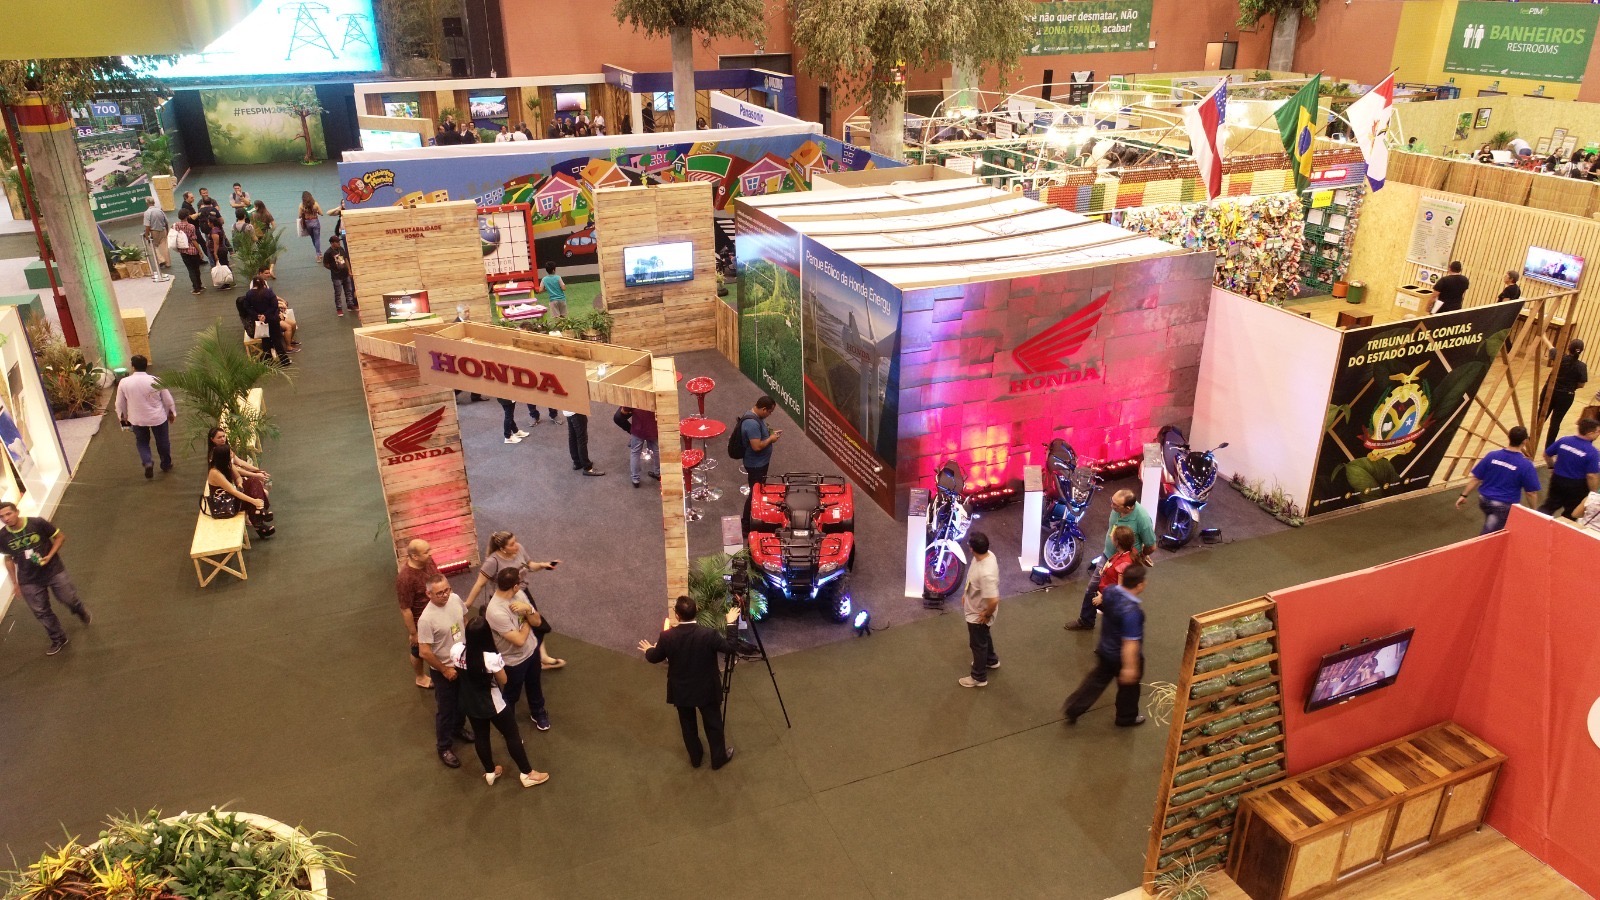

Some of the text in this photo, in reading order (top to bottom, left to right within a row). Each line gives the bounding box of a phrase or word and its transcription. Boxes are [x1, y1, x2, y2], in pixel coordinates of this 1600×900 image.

[1040, 12, 1055, 22] não
[1057, 13, 1076, 23] quer
[1078, 11, 1118, 21] desmatar,
[1121, 9, 1138, 20] NÃO
[1043, 25, 1066, 35] ZONA
[1102, 23, 1132, 34] acabar!
[1489, 25, 1586, 44] BANHEIROS
[1507, 42, 1559, 54] RESTROOMS
[95, 105, 116, 114] 700
[740, 103, 764, 123] Panasonic
[385, 225, 442, 235] SUSTENTABILIDADE
[806, 250, 824, 270] Parque
[840, 271, 848, 286] da
[848, 276, 868, 298] Honda
[868, 287, 891, 315] Energy
[1367, 323, 1472, 351] TRIBUNAL DE CONTAS
[1348, 332, 1483, 367] DO ESTADO DO AMAZONAS
[428, 350, 568, 396] HONDA
[763, 368, 781, 394] Projeto
[1009, 367, 1101, 394] HONDA
[387, 447, 455, 466] HONDA
